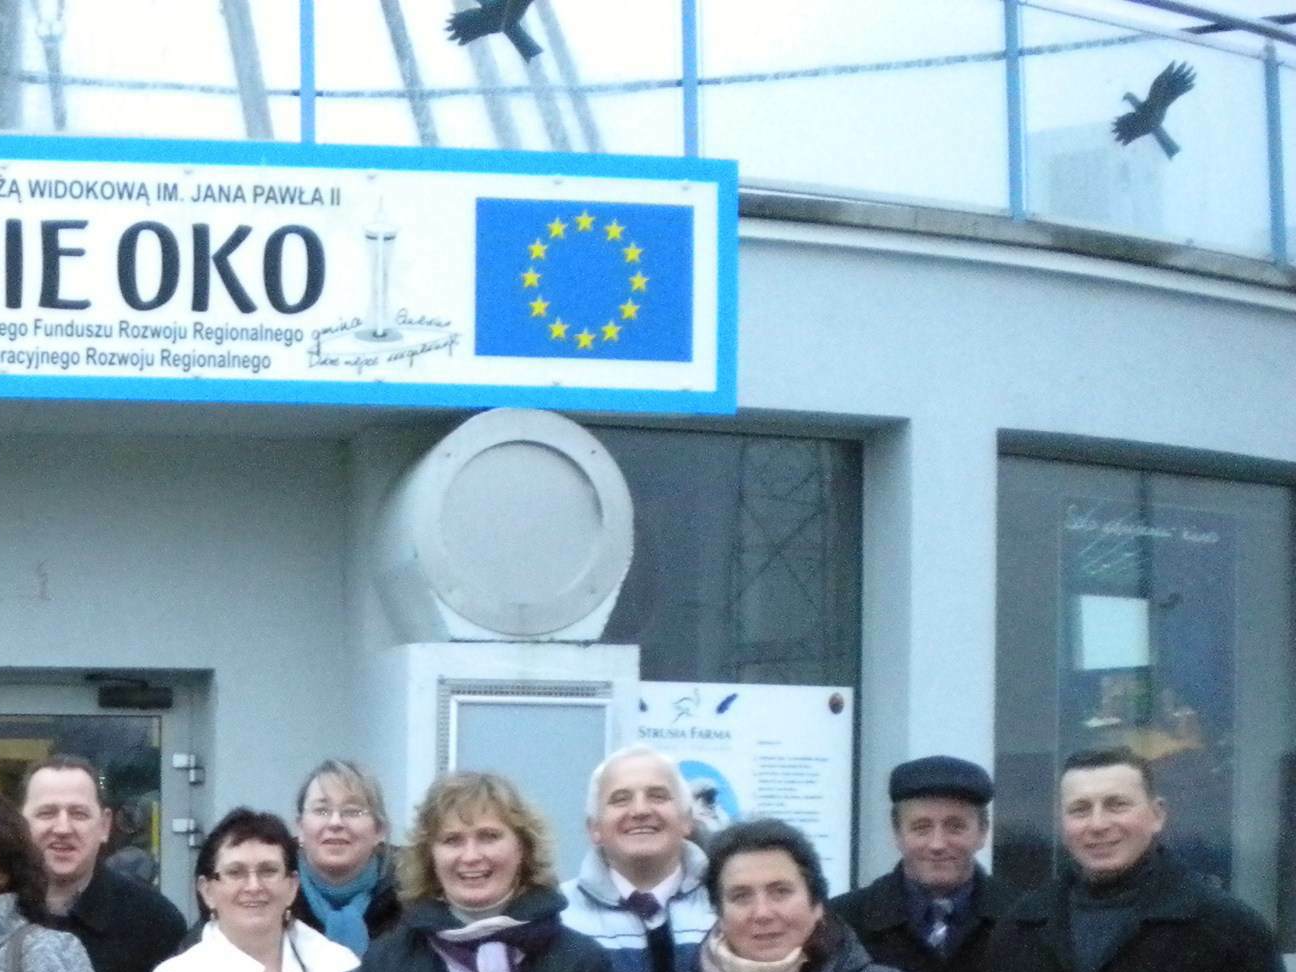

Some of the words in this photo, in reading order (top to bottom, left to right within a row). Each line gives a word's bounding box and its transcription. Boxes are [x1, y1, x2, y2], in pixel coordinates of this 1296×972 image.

[28, 179, 151, 206] WIDOKOWĄ
[156, 183, 184, 202] IM.
[190, 183, 247, 204] JANA
[253, 185, 325, 206] PAWŁA
[330, 187, 342, 206] II
[115, 220, 328, 315] OKO
[33, 318, 113, 339] Funduszu
[118, 320, 188, 344] Rozwoju
[192, 322, 304, 347] Regionalnego
[85, 347, 155, 371] Rozwoju
[160, 348, 272, 374] Regionalnego
